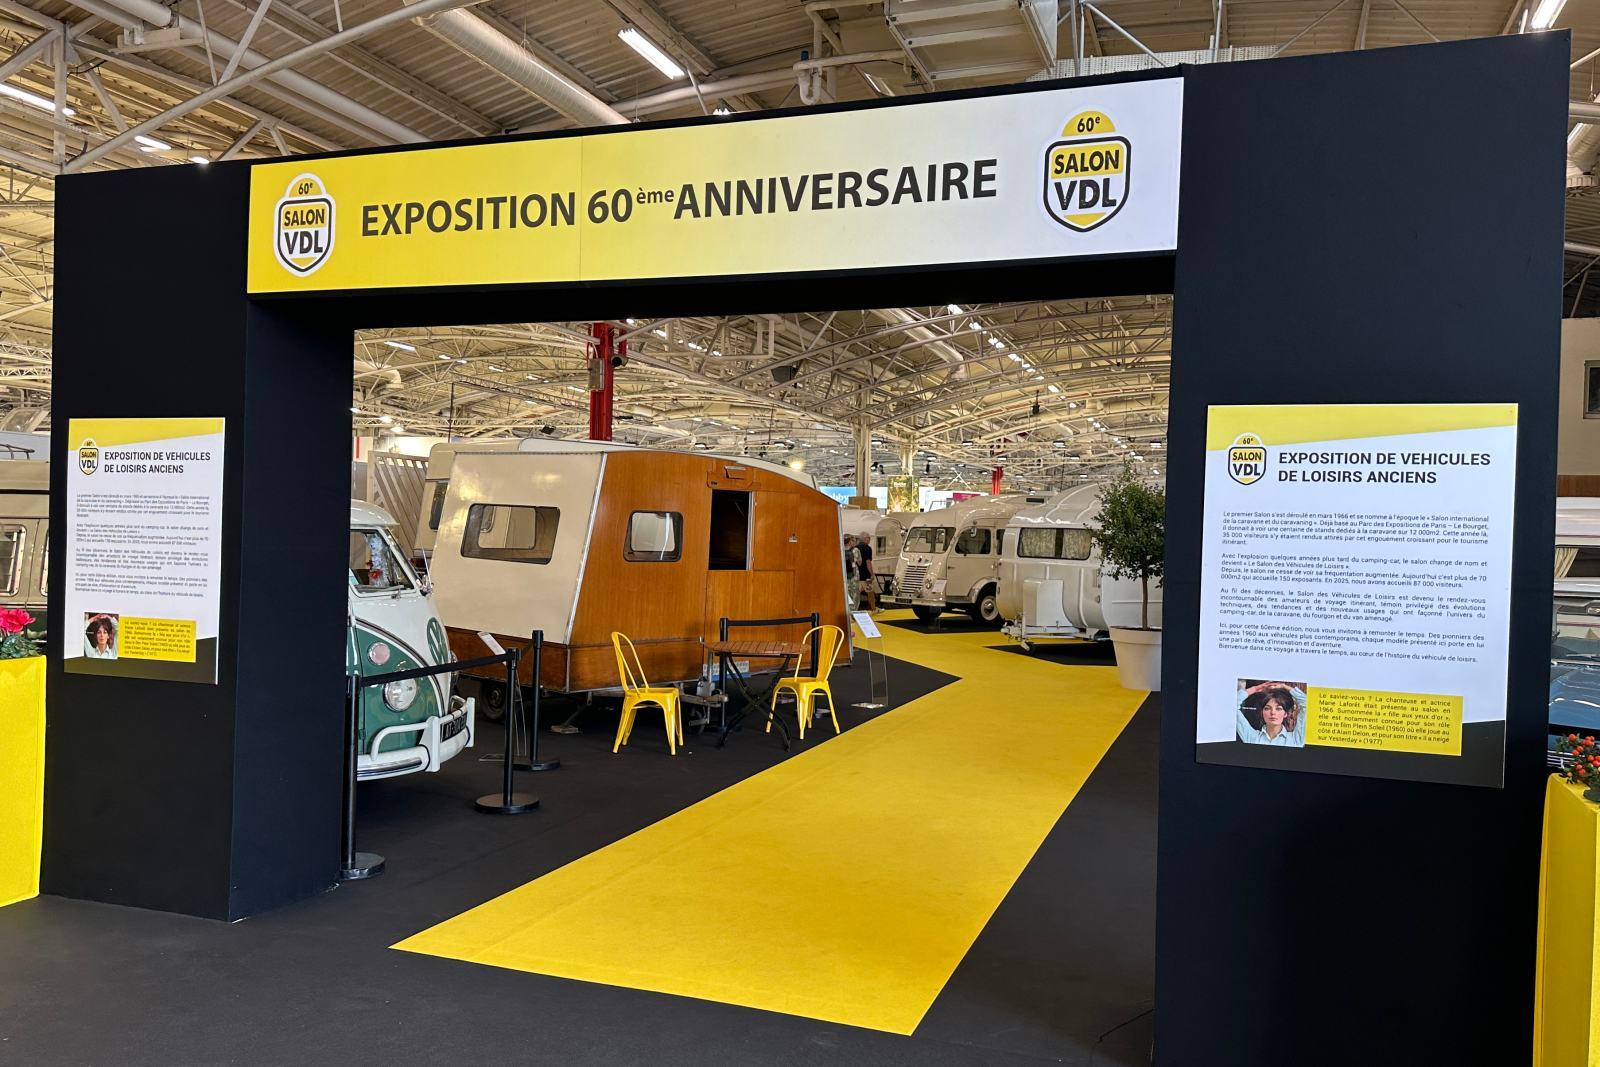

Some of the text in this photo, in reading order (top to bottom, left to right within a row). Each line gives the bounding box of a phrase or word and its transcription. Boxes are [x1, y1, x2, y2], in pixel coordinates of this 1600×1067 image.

[1054, 150, 1119, 174] SALON
[362, 159, 997, 236] EXPOSITION 60ème ANNIVERSAIRE
[1054, 178, 1117, 210] VDL
[284, 209, 325, 226] SALON
[284, 230, 323, 254] VDL
[104, 451, 211, 461] EXPOSITION DE VEHICULES
[1232, 452, 1262, 461] SALON
[1279, 452, 1490, 466] EXPOSITION DE VEHICULES
[81, 460, 96, 468] VDL
[104, 464, 184, 474] DE LOISIRS ANCIENS
[1233, 463, 1260, 476] VDL
[1278, 470, 1437, 484] DE LOISIRS ANCIENS
[1328, 736, 1357, 744] Yesterday
